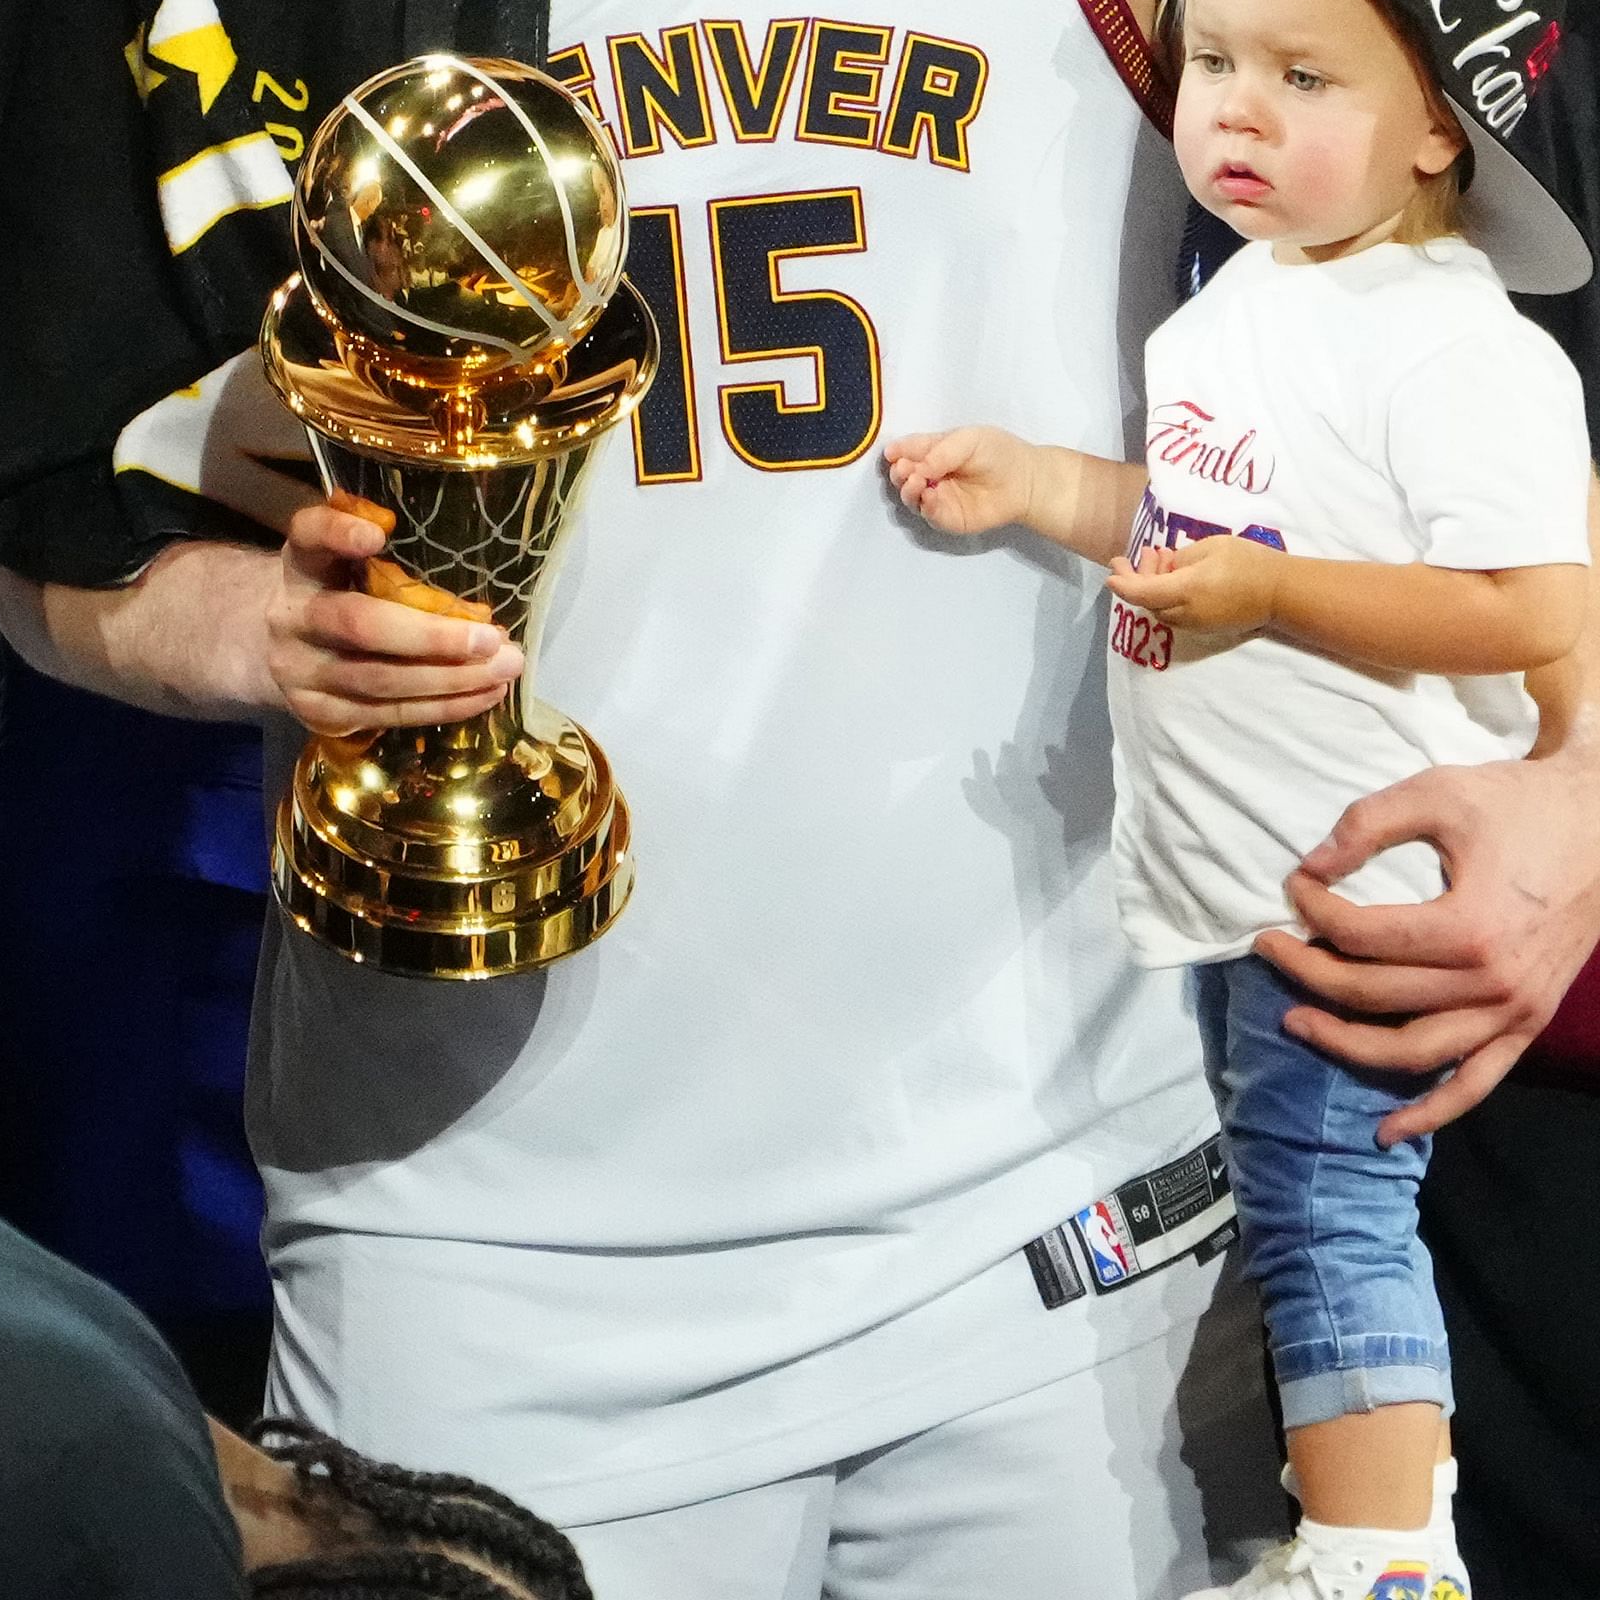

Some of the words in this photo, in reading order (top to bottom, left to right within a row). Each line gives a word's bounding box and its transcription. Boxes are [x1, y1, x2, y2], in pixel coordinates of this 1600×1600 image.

[630, 186, 885, 487] 15
[1147, 400, 1277, 492] Finals
[1111, 602, 1175, 673] 2023
[1131, 1203, 1151, 1224] 58
